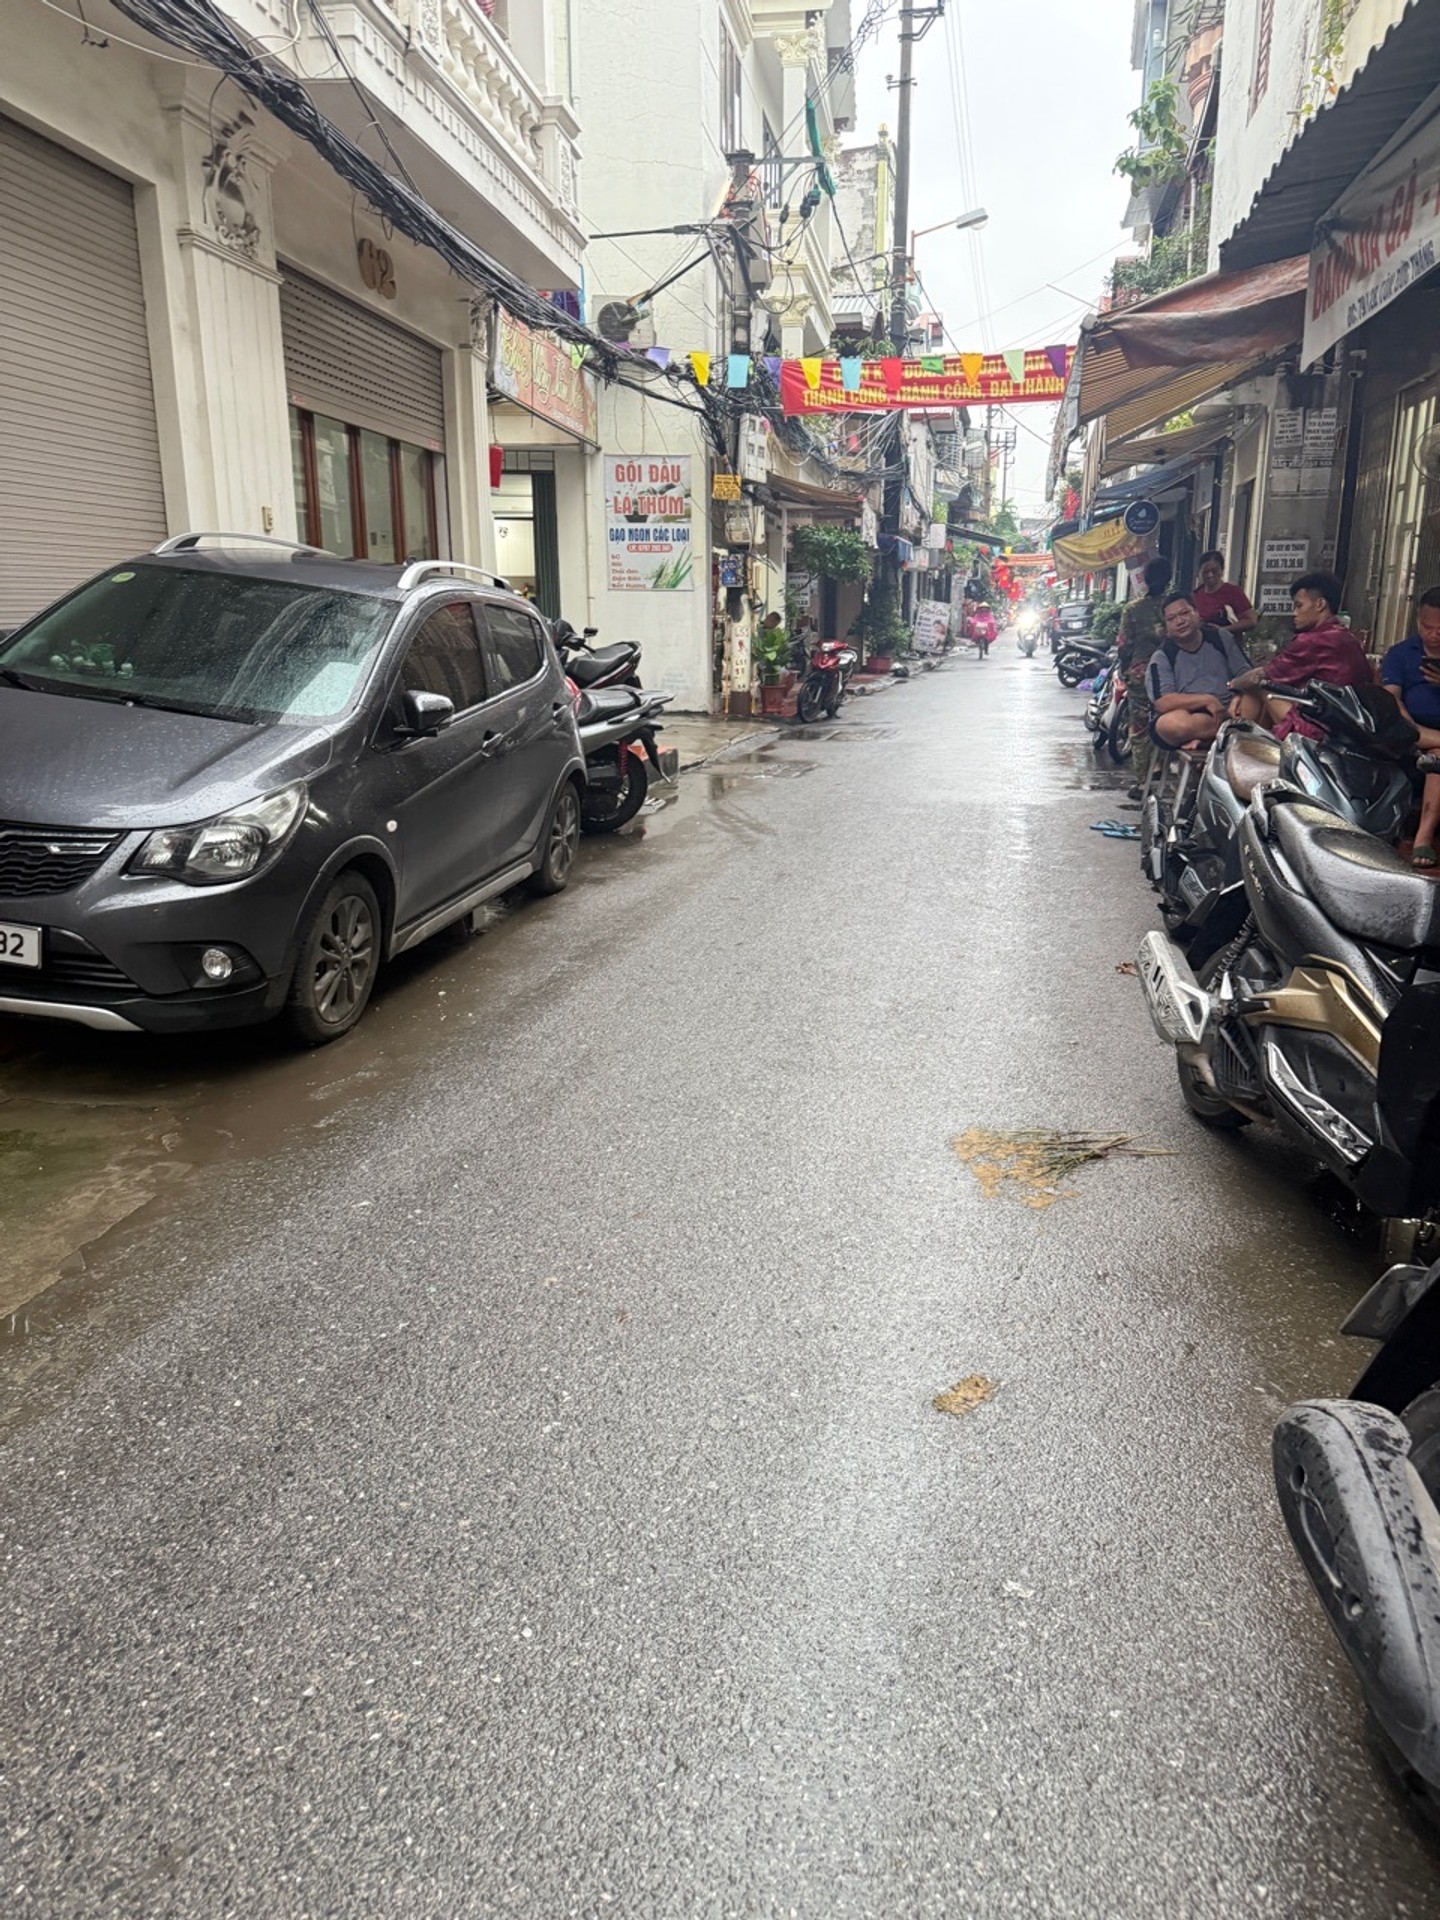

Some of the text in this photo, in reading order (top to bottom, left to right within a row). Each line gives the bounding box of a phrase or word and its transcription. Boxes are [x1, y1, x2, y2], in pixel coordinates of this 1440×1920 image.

[615, 457, 681, 488] GỘI ĐẦU
[638, 494, 683, 514] THƠM
[609, 528, 626, 544] GẠO
[628, 528, 651, 541] NGON
[671, 528, 690, 545] LOẠI
